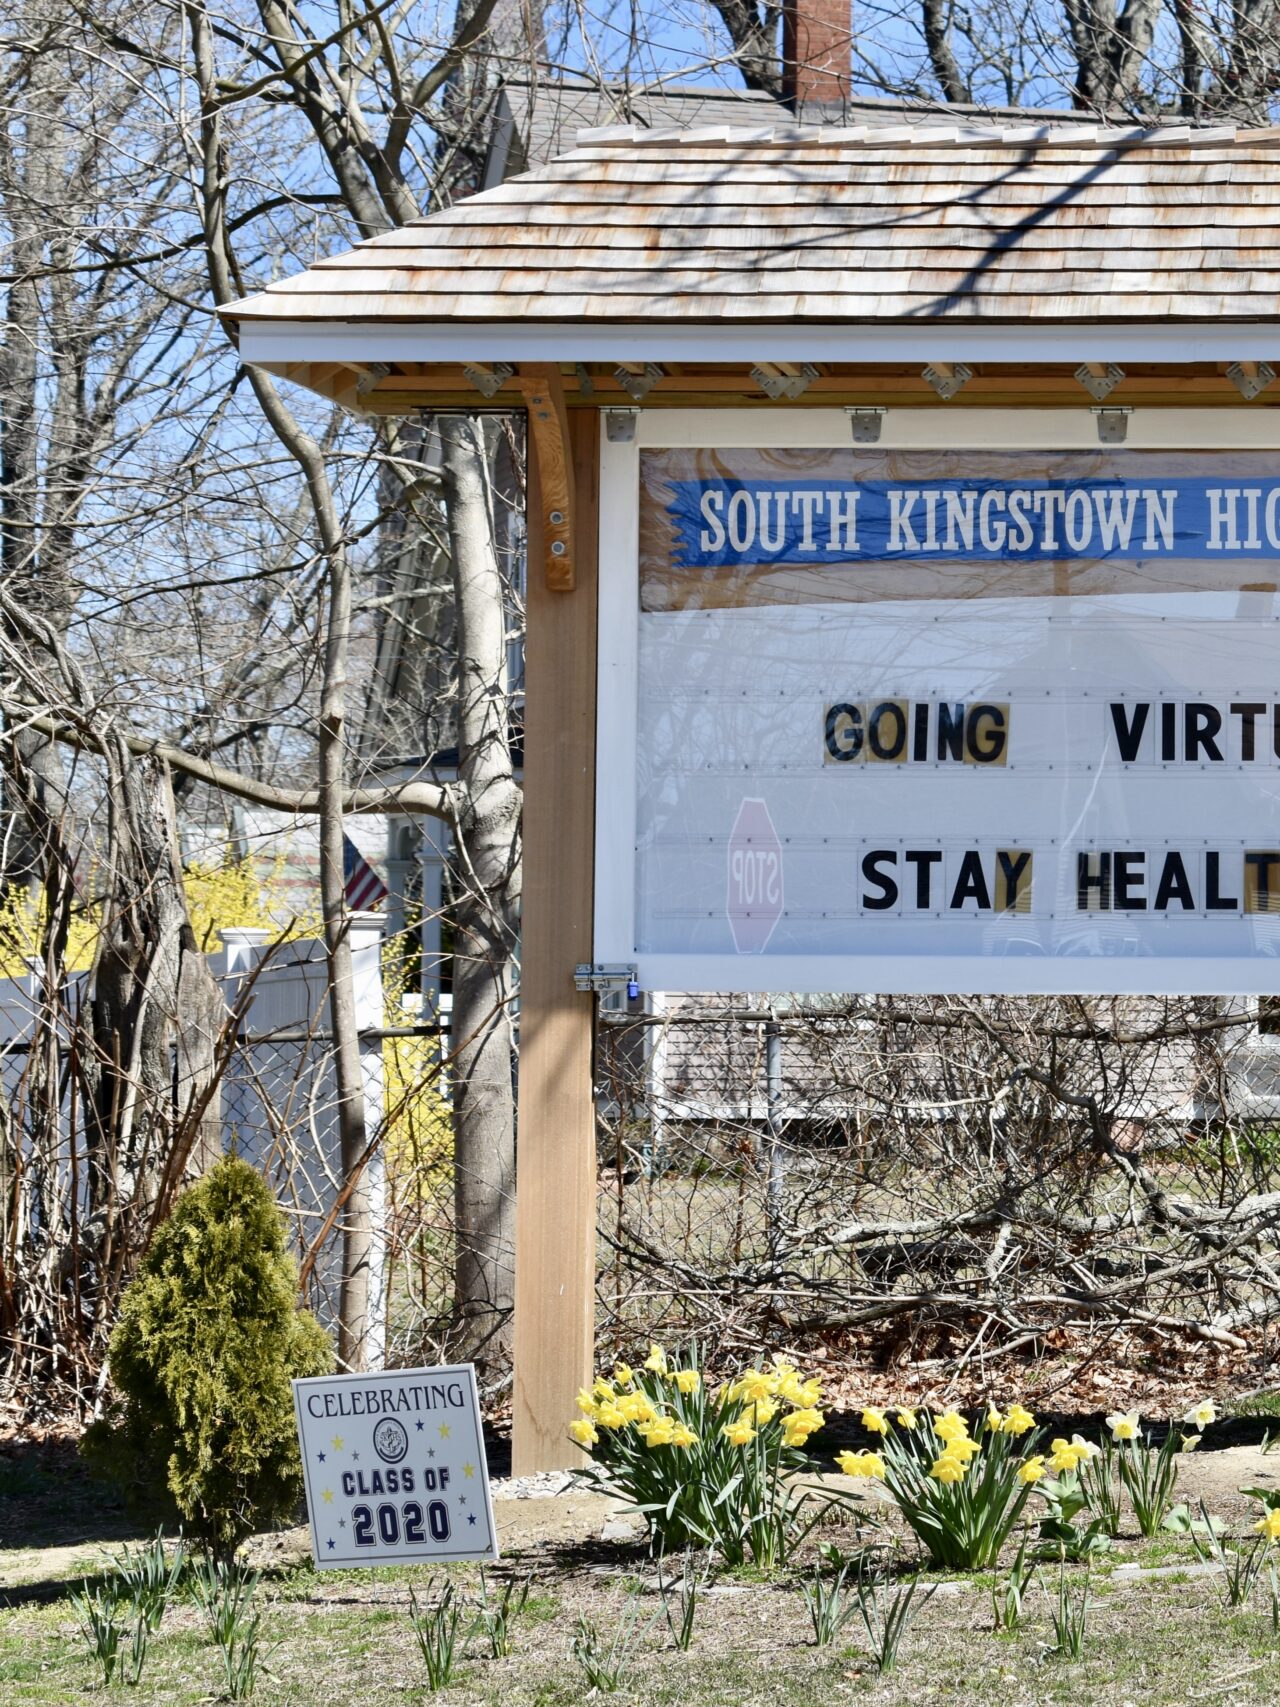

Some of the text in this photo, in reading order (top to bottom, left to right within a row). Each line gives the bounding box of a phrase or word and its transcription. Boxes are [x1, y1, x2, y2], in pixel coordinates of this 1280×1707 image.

[700, 490, 860, 552] SOUTH
[886, 488, 1178, 552] KINGSTOWN
[825, 702, 1007, 762] GOING
[861, 850, 1031, 910] STAY
[307, 1383, 465, 1418] CELEBRATING
[341, 1466, 450, 1497] CLASS OF
[352, 1499, 451, 1547] 2020
